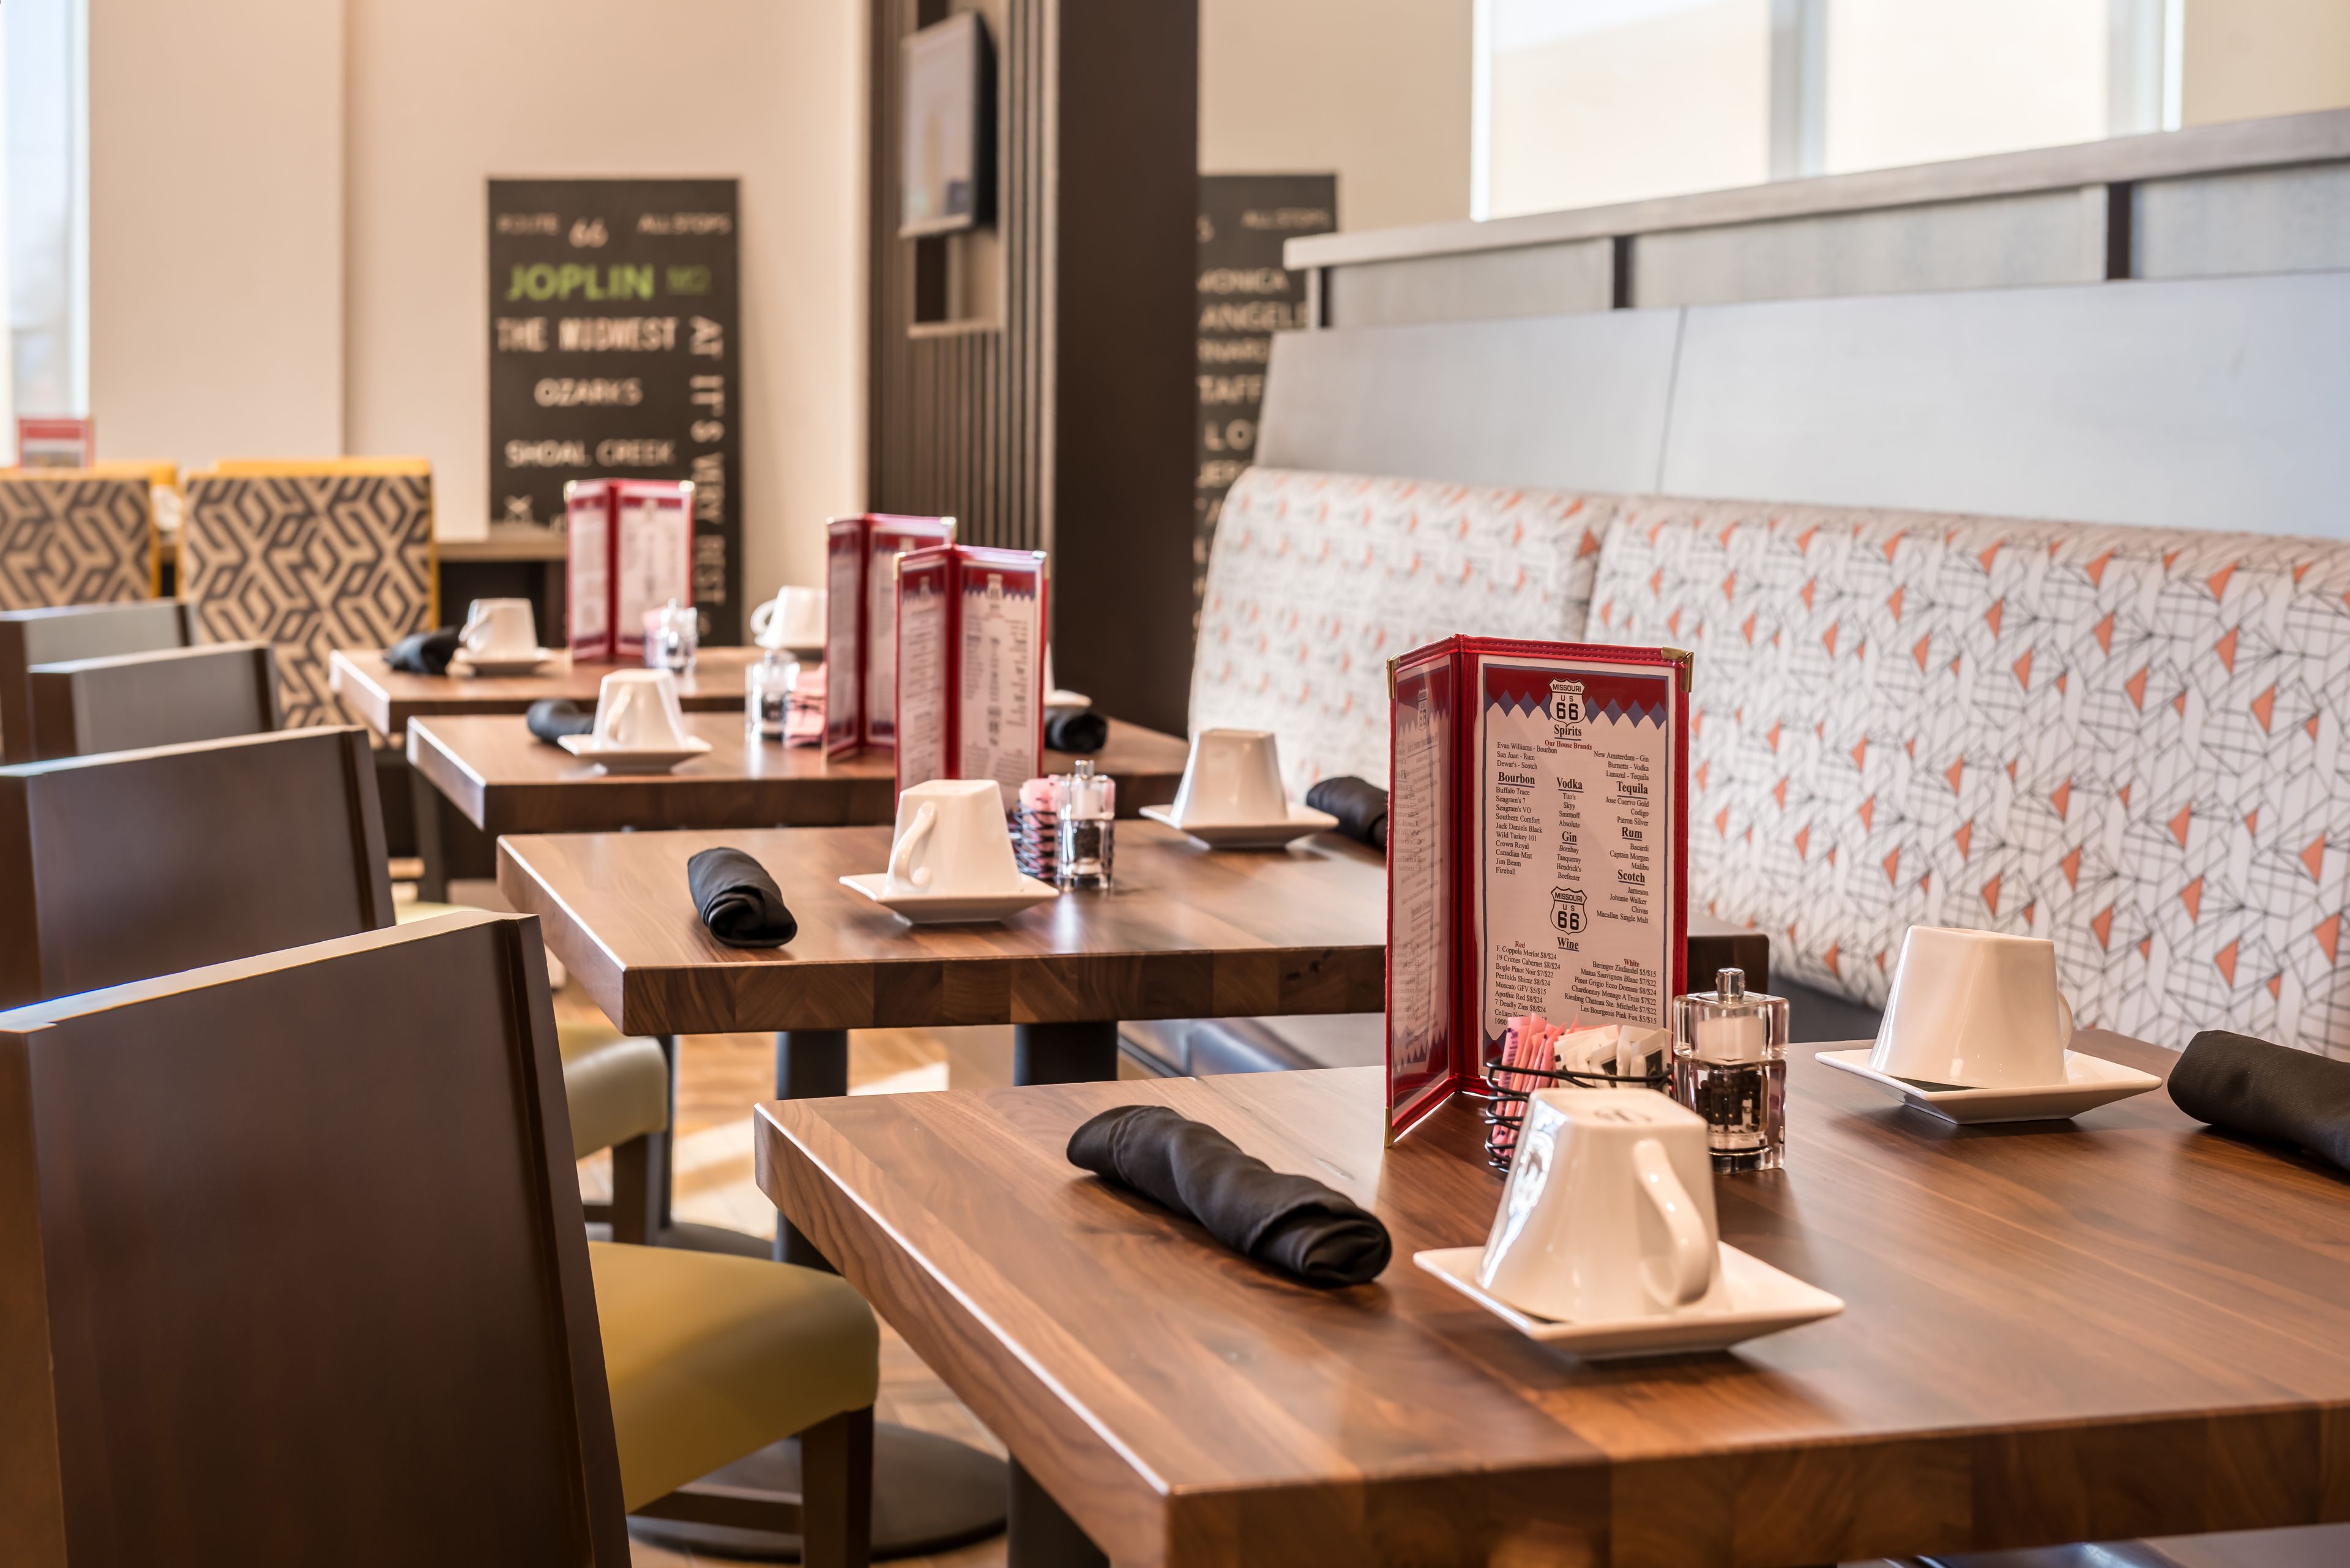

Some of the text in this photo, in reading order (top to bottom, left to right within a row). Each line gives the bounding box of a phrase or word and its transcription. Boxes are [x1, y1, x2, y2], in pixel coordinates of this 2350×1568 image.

[569, 216, 608, 247] 66
[506, 263, 654, 301] JOPLIN
[495, 316, 679, 351] THE MIDWEST
[690, 315, 724, 361] AT
[534, 378, 643, 406] OZARKS
[505, 439, 675, 467] SHOAL CREEK
[1556, 702, 1578, 720] 66
[1554, 725, 1581, 737] Spirits
[1606, 752, 1635, 761] Amsterdam
[1498, 772, 1535, 784] Bourbon
[1557, 777, 1582, 790] Vodka
[1617, 781, 1648, 795] Tequila
[1631, 808, 1649, 818] Codigo
[1510, 833, 1527, 842] Turkey
[1562, 831, 1576, 842] Gin
[1622, 827, 1642, 838] Rum
[1559, 845, 1579, 854] Bombay
[1557, 854, 1581, 864] Tanqueray
[1610, 850, 1649, 862] Captain Morgan
[1557, 863, 1581, 872] Hendrick's
[1558, 872, 1580, 881] Beefeater
[1618, 869, 1645, 883] Scotch
[1555, 892, 1583, 902] MISSOURI
[1628, 887, 1648, 895] Jameson
[1558, 911, 1579, 930] 66
[1597, 910, 1619, 919] Macallan
[1621, 914, 1635, 922] Single
[1557, 937, 1579, 949] Wine
[1502, 946, 1522, 955] Coppola
[1496, 963, 1510, 972] Bogle
[1522, 958, 1543, 967] Cabernet
[1593, 961, 1656, 977] Beringer Zinfandel $5/$15
[1496, 972, 1516, 981] Penfolds
[1518, 976, 1532, 984] Shiraz
[1597, 971, 1622, 980] Sauvignon
[1639, 978, 1656, 987] $7/$22
[1496, 981, 1516, 990] Moscato
[1589, 979, 1604, 988] Grigio
[1619, 984, 1638, 993] Domani
[1639, 987, 1656, 996] $8/$24
[1495, 990, 1514, 999] Apothic
[1572, 985, 1600, 997] Chardonnay
[1602, 990, 1621, 1000] Menage
[1500, 999, 1516, 1009] Deadly
[1565, 993, 1584, 1004] Riesling
[1585, 996, 1604, 1006] Chateau
[1616, 1002, 1638, 1012] Michelle
[1639, 1006, 1656, 1015] $7/$22
[1495, 1009, 1512, 1018] Cellars
[1591, 1007, 1614, 1017] Bourgeois
[1639, 1015, 1657, 1024] $5/$15
